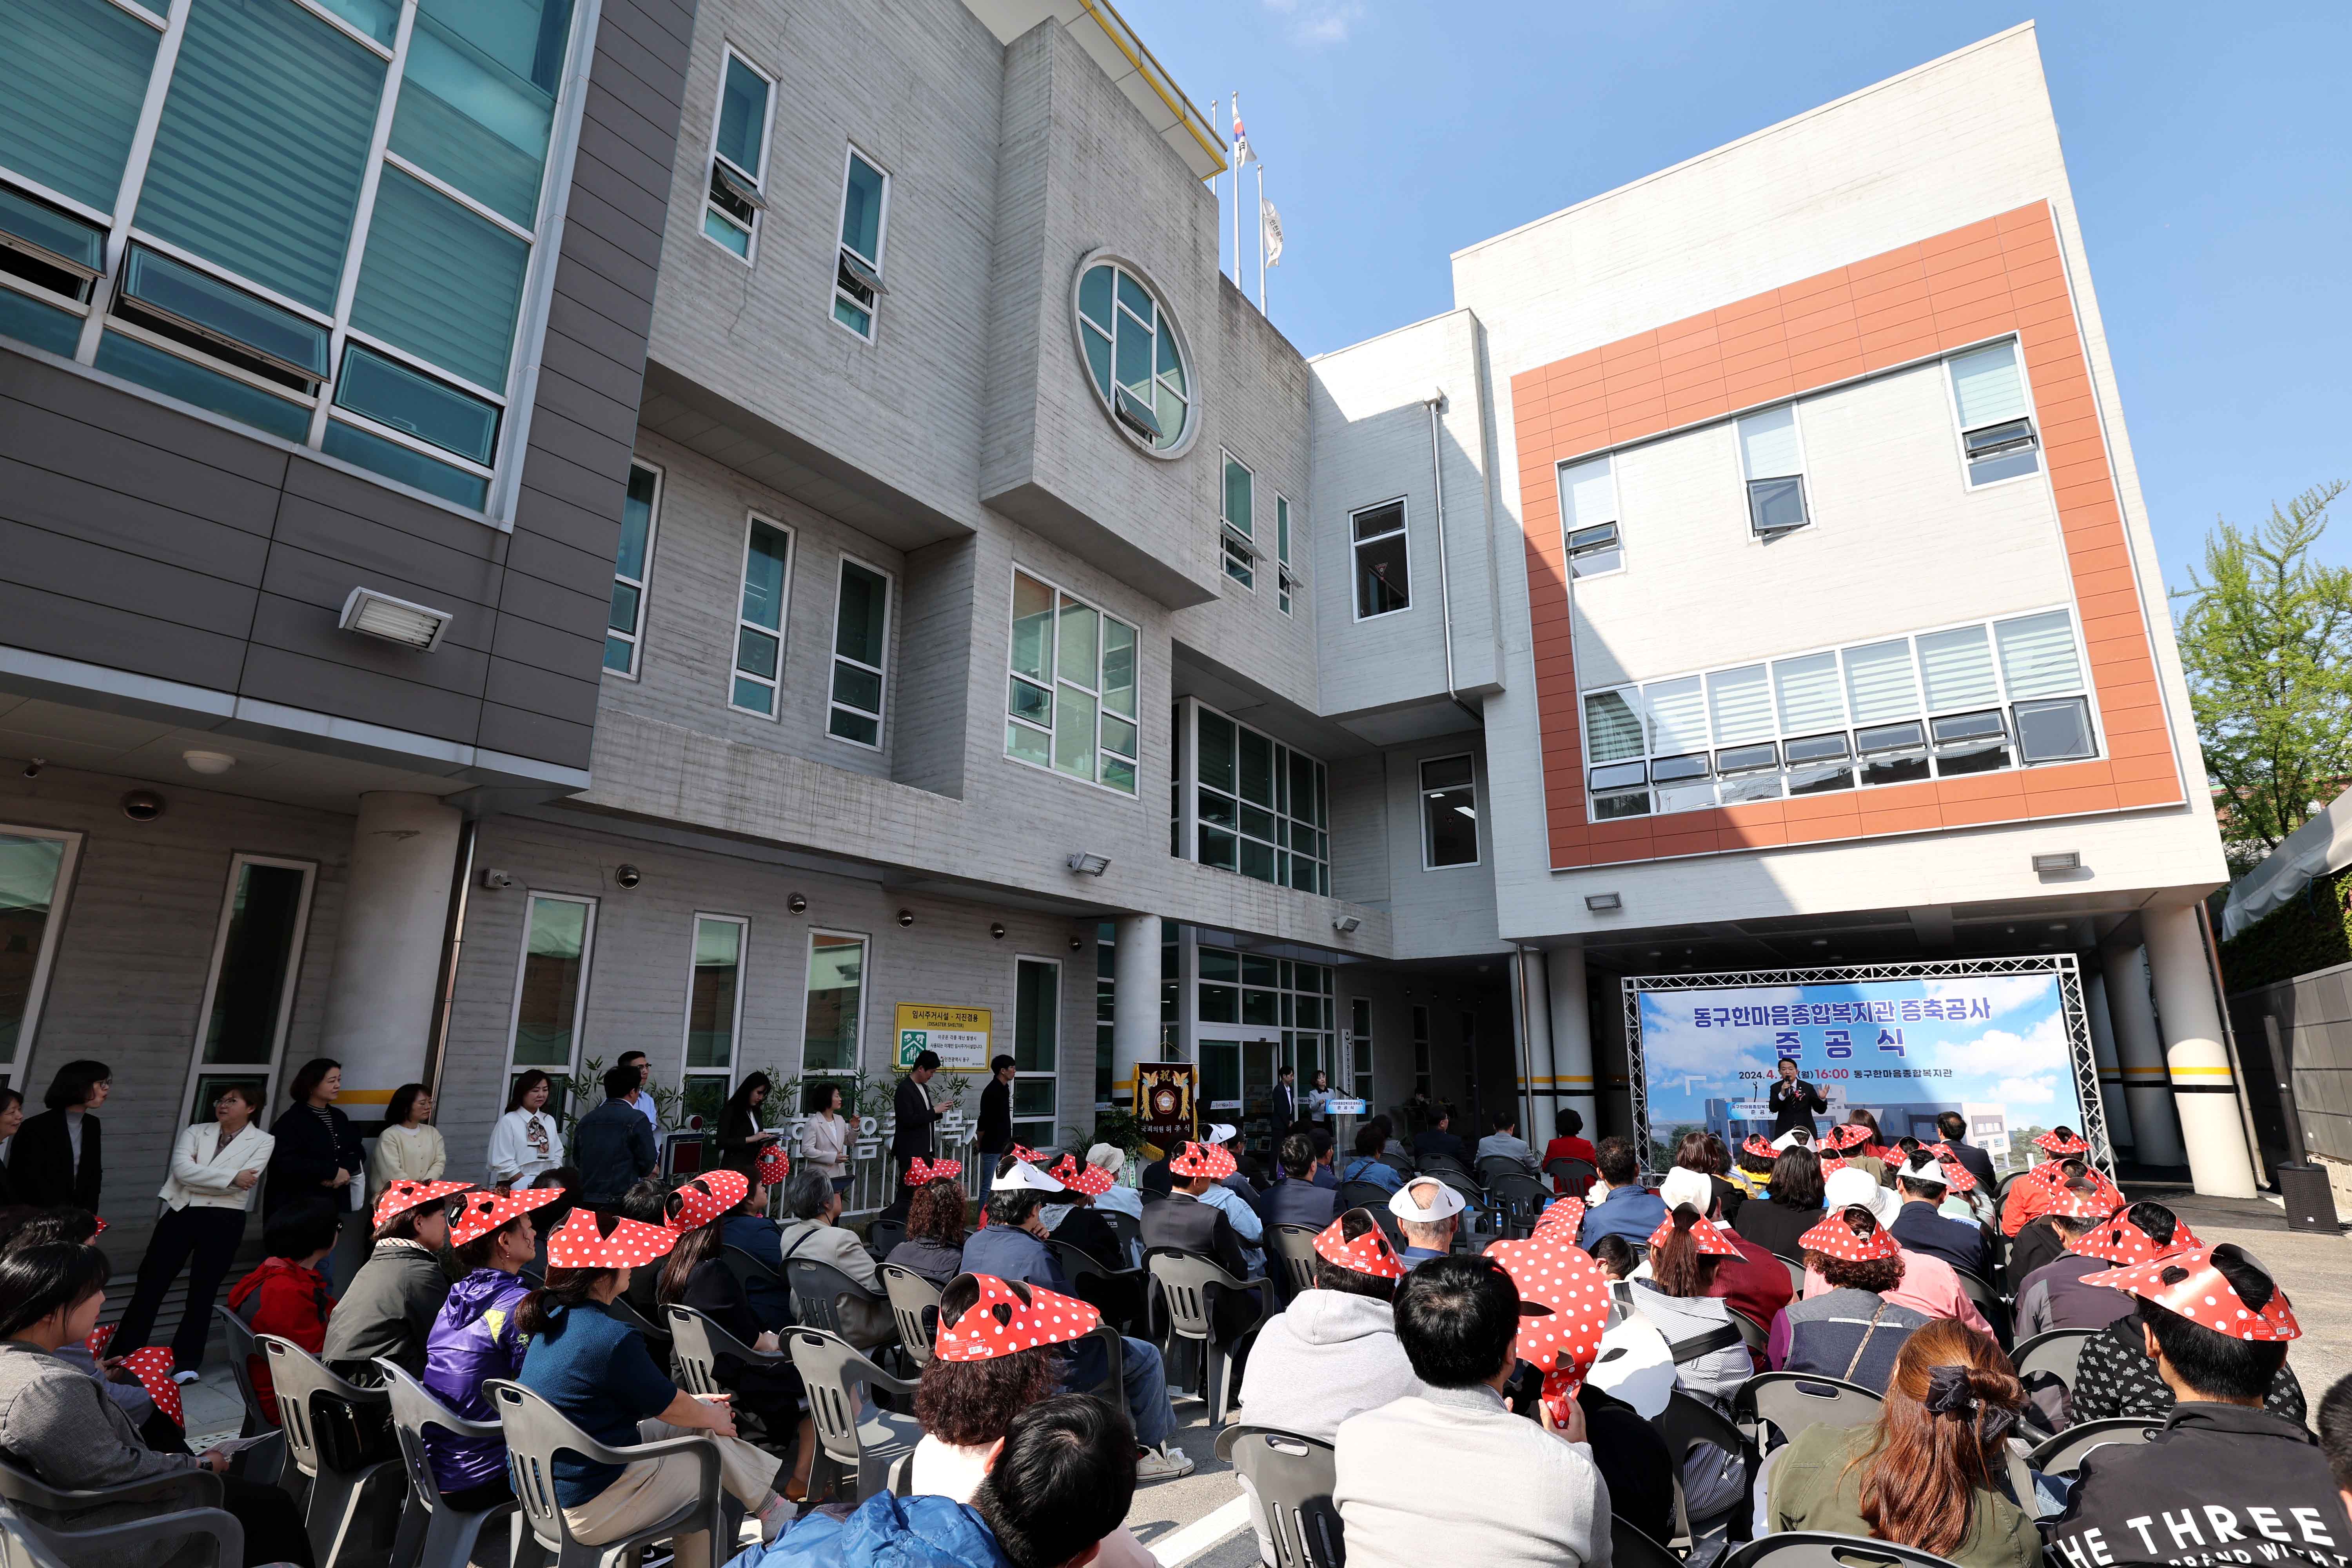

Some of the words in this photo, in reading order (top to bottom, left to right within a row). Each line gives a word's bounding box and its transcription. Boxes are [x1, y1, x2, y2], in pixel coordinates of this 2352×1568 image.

[912, 1010, 949, 1020] 임시주거시설
[956, 1013, 978, 1022] 지진겸용
[1694, 1000, 1895, 1028] 동구한마음종합복지관
[1900, 997, 1991, 1022] 증축공사
[1775, 1031, 1802, 1059] 준
[1824, 1030, 1852, 1059] 공
[1877, 1027, 1906, 1057] 식
[1815, 1068, 1849, 1080] 16:00
[1853, 1069, 1953, 1079] 동구한마음종합복지관
[2126, 1504, 2335, 1555] THREE
[2257, 1543, 2329, 1567] WITH
